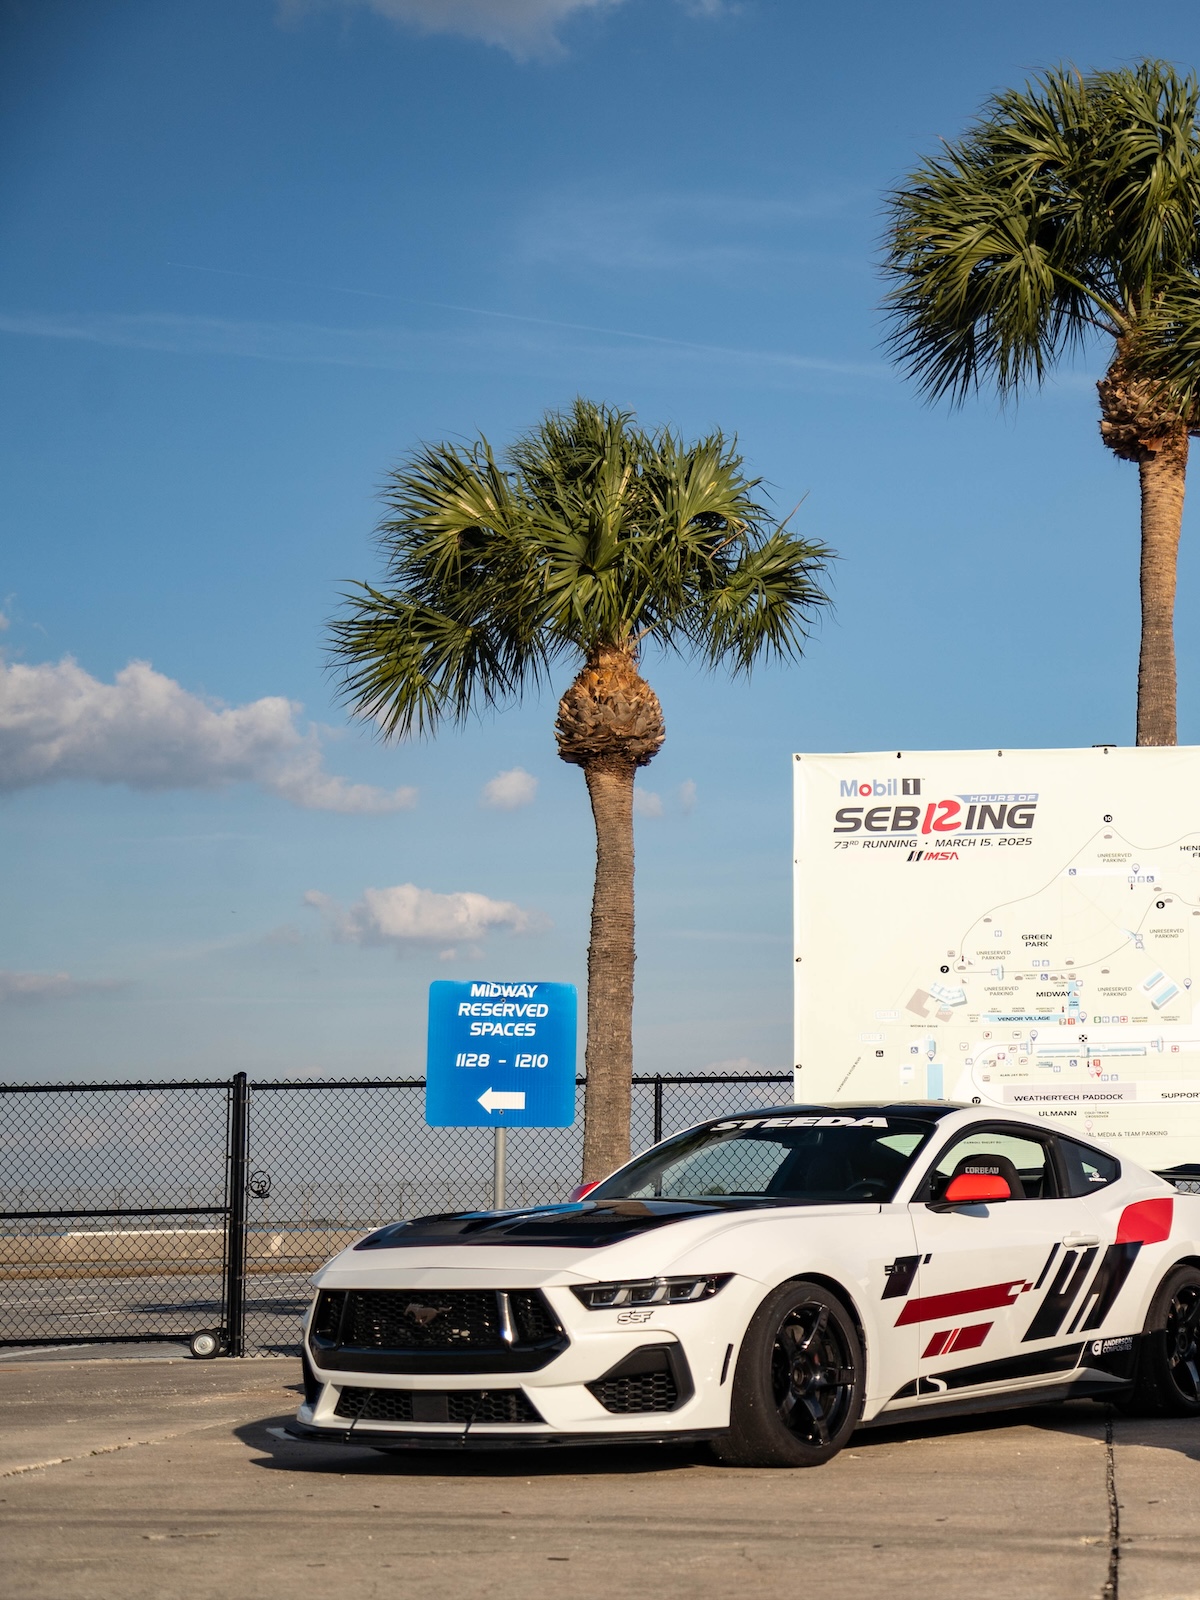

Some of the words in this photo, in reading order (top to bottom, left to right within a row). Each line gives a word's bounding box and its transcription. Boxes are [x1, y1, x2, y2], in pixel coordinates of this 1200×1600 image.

[840, 778, 898, 797] Mobil
[904, 779, 918, 795] 1
[970, 795, 1016, 803] HOURS
[1018, 794, 1037, 802] OF
[863, 839, 918, 849] RUNNING
[935, 838, 976, 847] MARCH
[998, 837, 1033, 846] 2025
[923, 851, 959, 860] IMSA
[470, 983, 538, 998] MIDWAY
[458, 1002, 549, 1018] RESERVED
[469, 1022, 537, 1037] SPACES
[455, 1053, 490, 1068] 1128
[514, 1053, 549, 1069] 1210
[1014, 1094, 1080, 1102] WEATHERTECH
[710, 1116, 888, 1132] STEEDA
[965, 1166, 999, 1174] CORBEAU
[1103, 1336, 1133, 1347] ANDERSON
